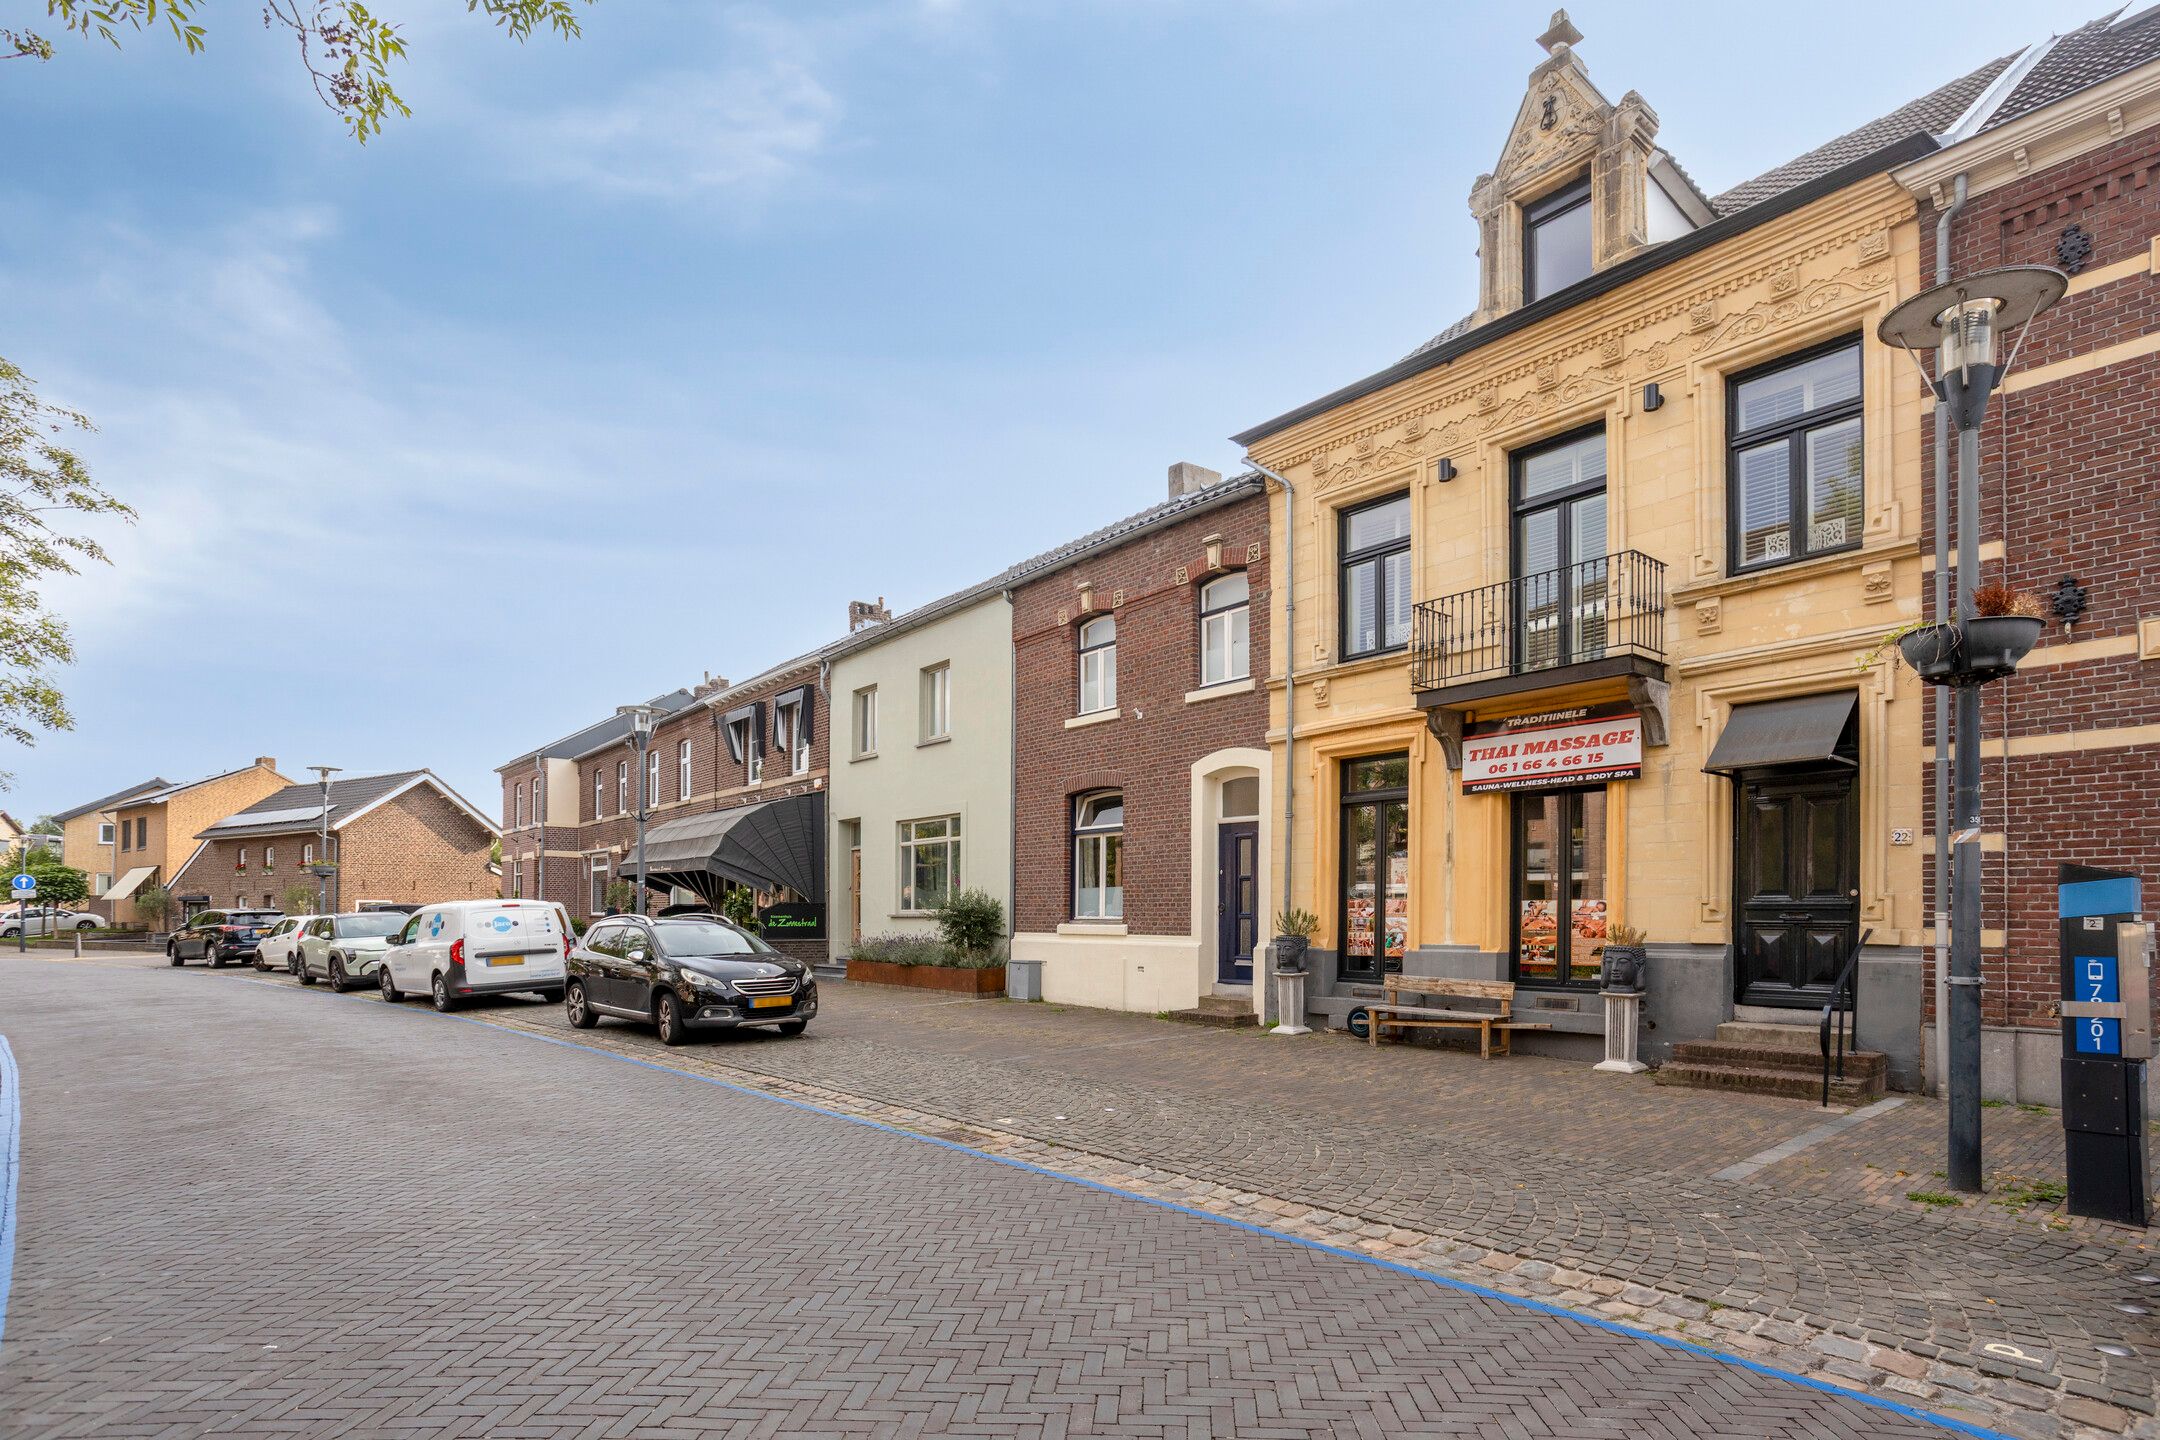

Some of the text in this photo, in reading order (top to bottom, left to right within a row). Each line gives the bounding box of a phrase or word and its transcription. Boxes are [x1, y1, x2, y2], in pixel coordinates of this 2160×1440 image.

[1507, 708, 1587, 727] TRADITIINELE
[1469, 729, 1635, 762] THAI MASSAGE
[1488, 752, 1604, 775] 06 1 66 4 66 15
[1471, 776, 1575, 792] SAUNA-WELLNESS-HEAD
[1586, 771, 1613, 780] BODY
[1614, 770, 1634, 778] SPA
[1894, 832, 1908, 842] 22
[2089, 919, 2097, 928] 2
